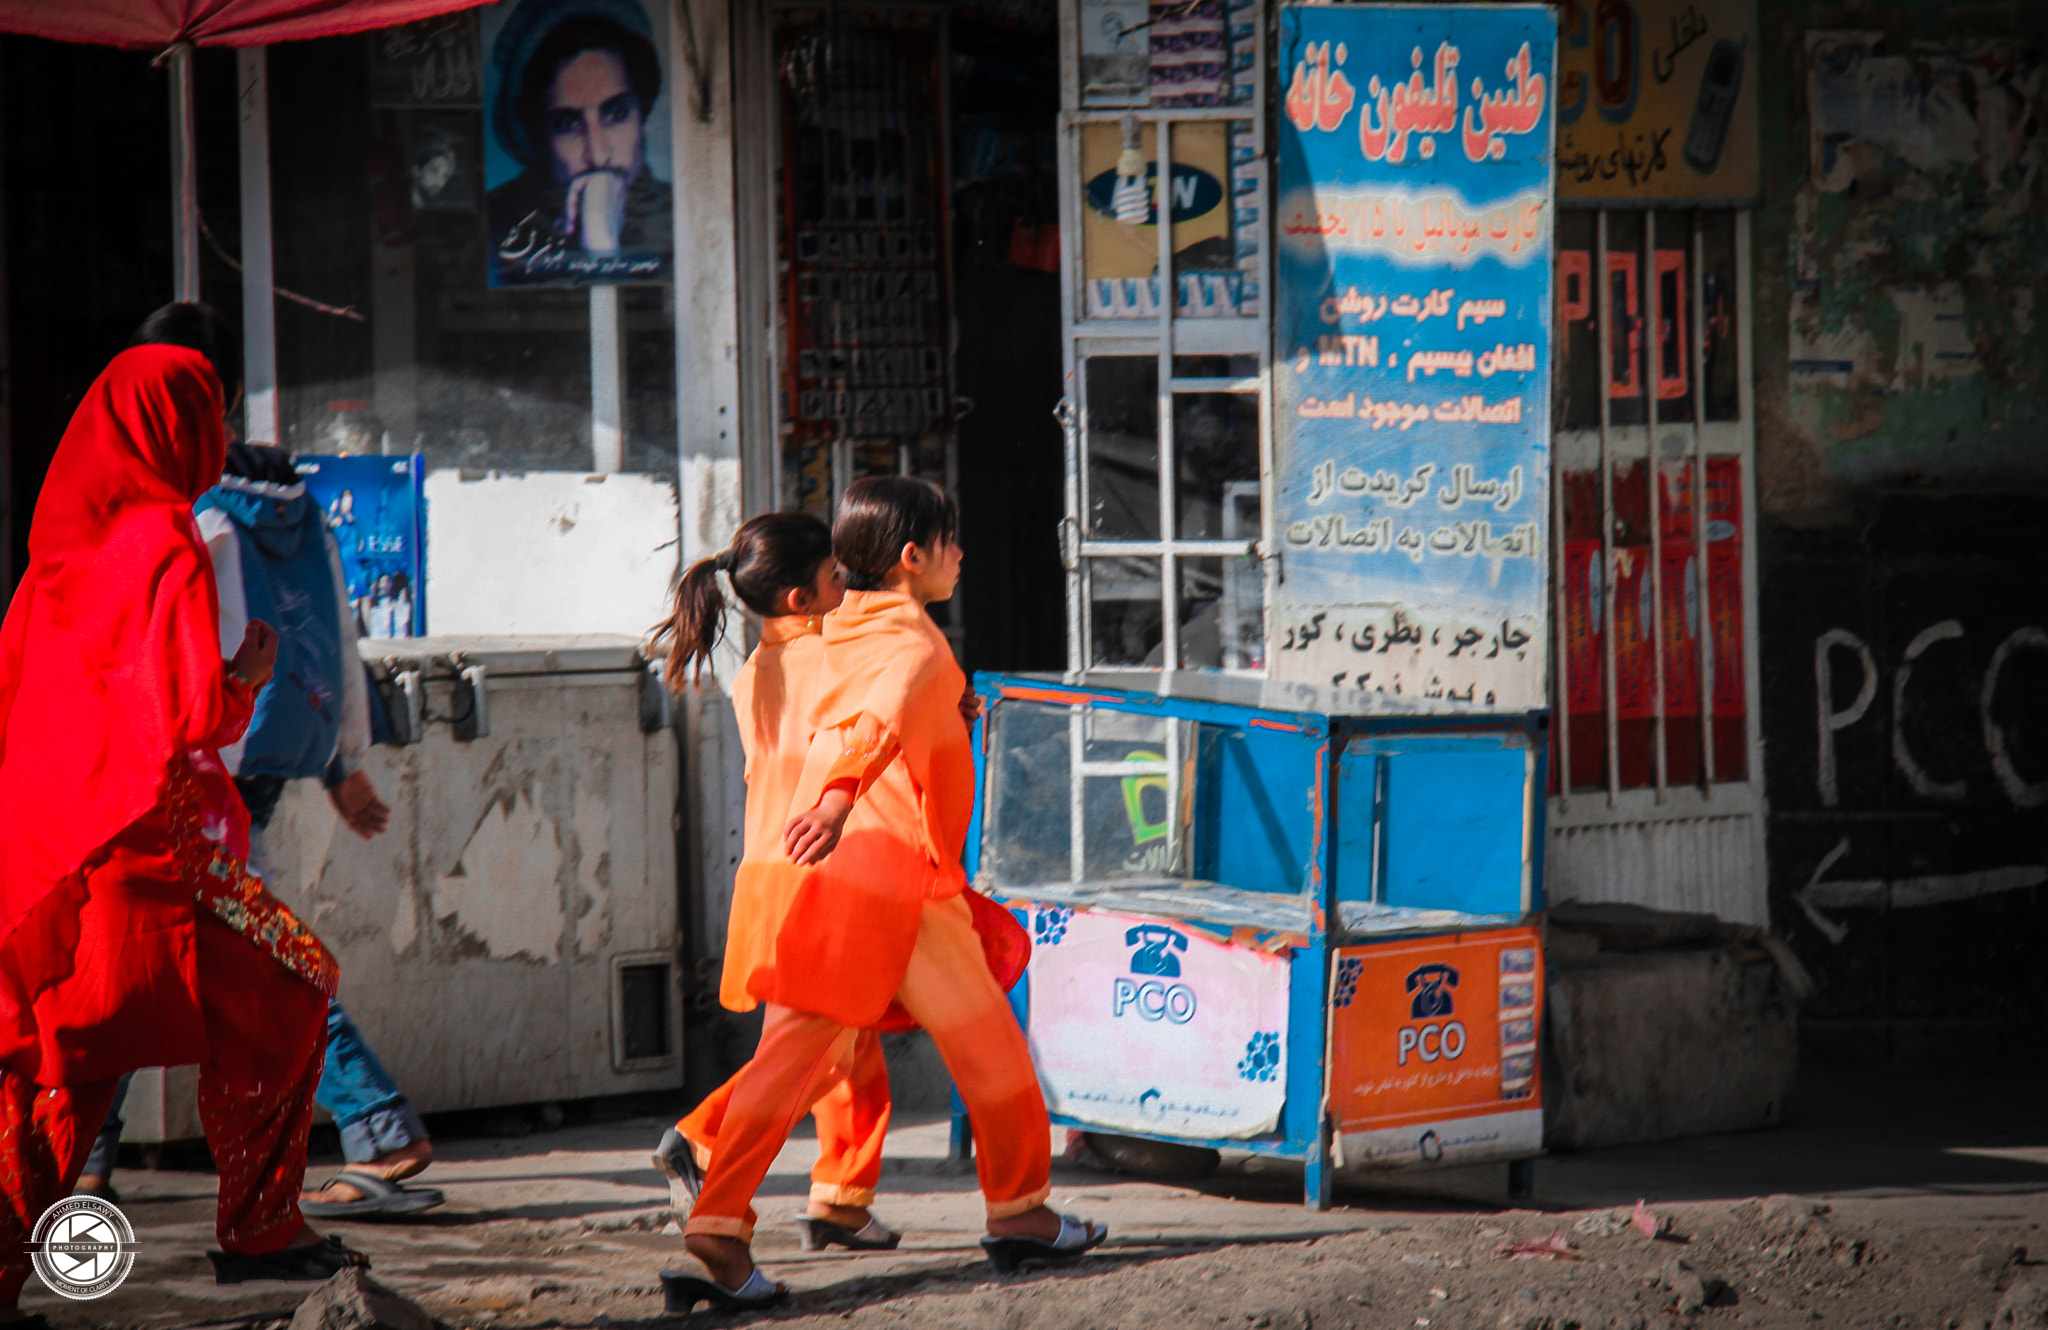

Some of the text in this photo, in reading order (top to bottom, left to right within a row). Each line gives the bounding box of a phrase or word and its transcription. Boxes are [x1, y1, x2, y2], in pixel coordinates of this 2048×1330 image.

[1286, 40, 1356, 132] خانه
[1359, 40, 1460, 164] تلیفون
[1462, 40, 1546, 163] طنین
[1283, 200, 1350, 246] تخفیف
[1487, 201, 1542, 253] کارت
[1319, 285, 1507, 331] سیم کارت روشن
[1295, 346, 1312, 374] و
[1318, 334, 1379, 367] MTN
[1477, 343, 1536, 377] افغان
[1297, 391, 1522, 431] اتصالات موجود است
[1306, 459, 1522, 510] ارسال کریدت از
[1285, 514, 1539, 563] اتصالات به اتصالات
[1281, 612, 1327, 650] کور
[1447, 619, 1531, 661] چارجر
[1113, 977, 1197, 1024] PCO
[1397, 1020, 1466, 1067] PCO
